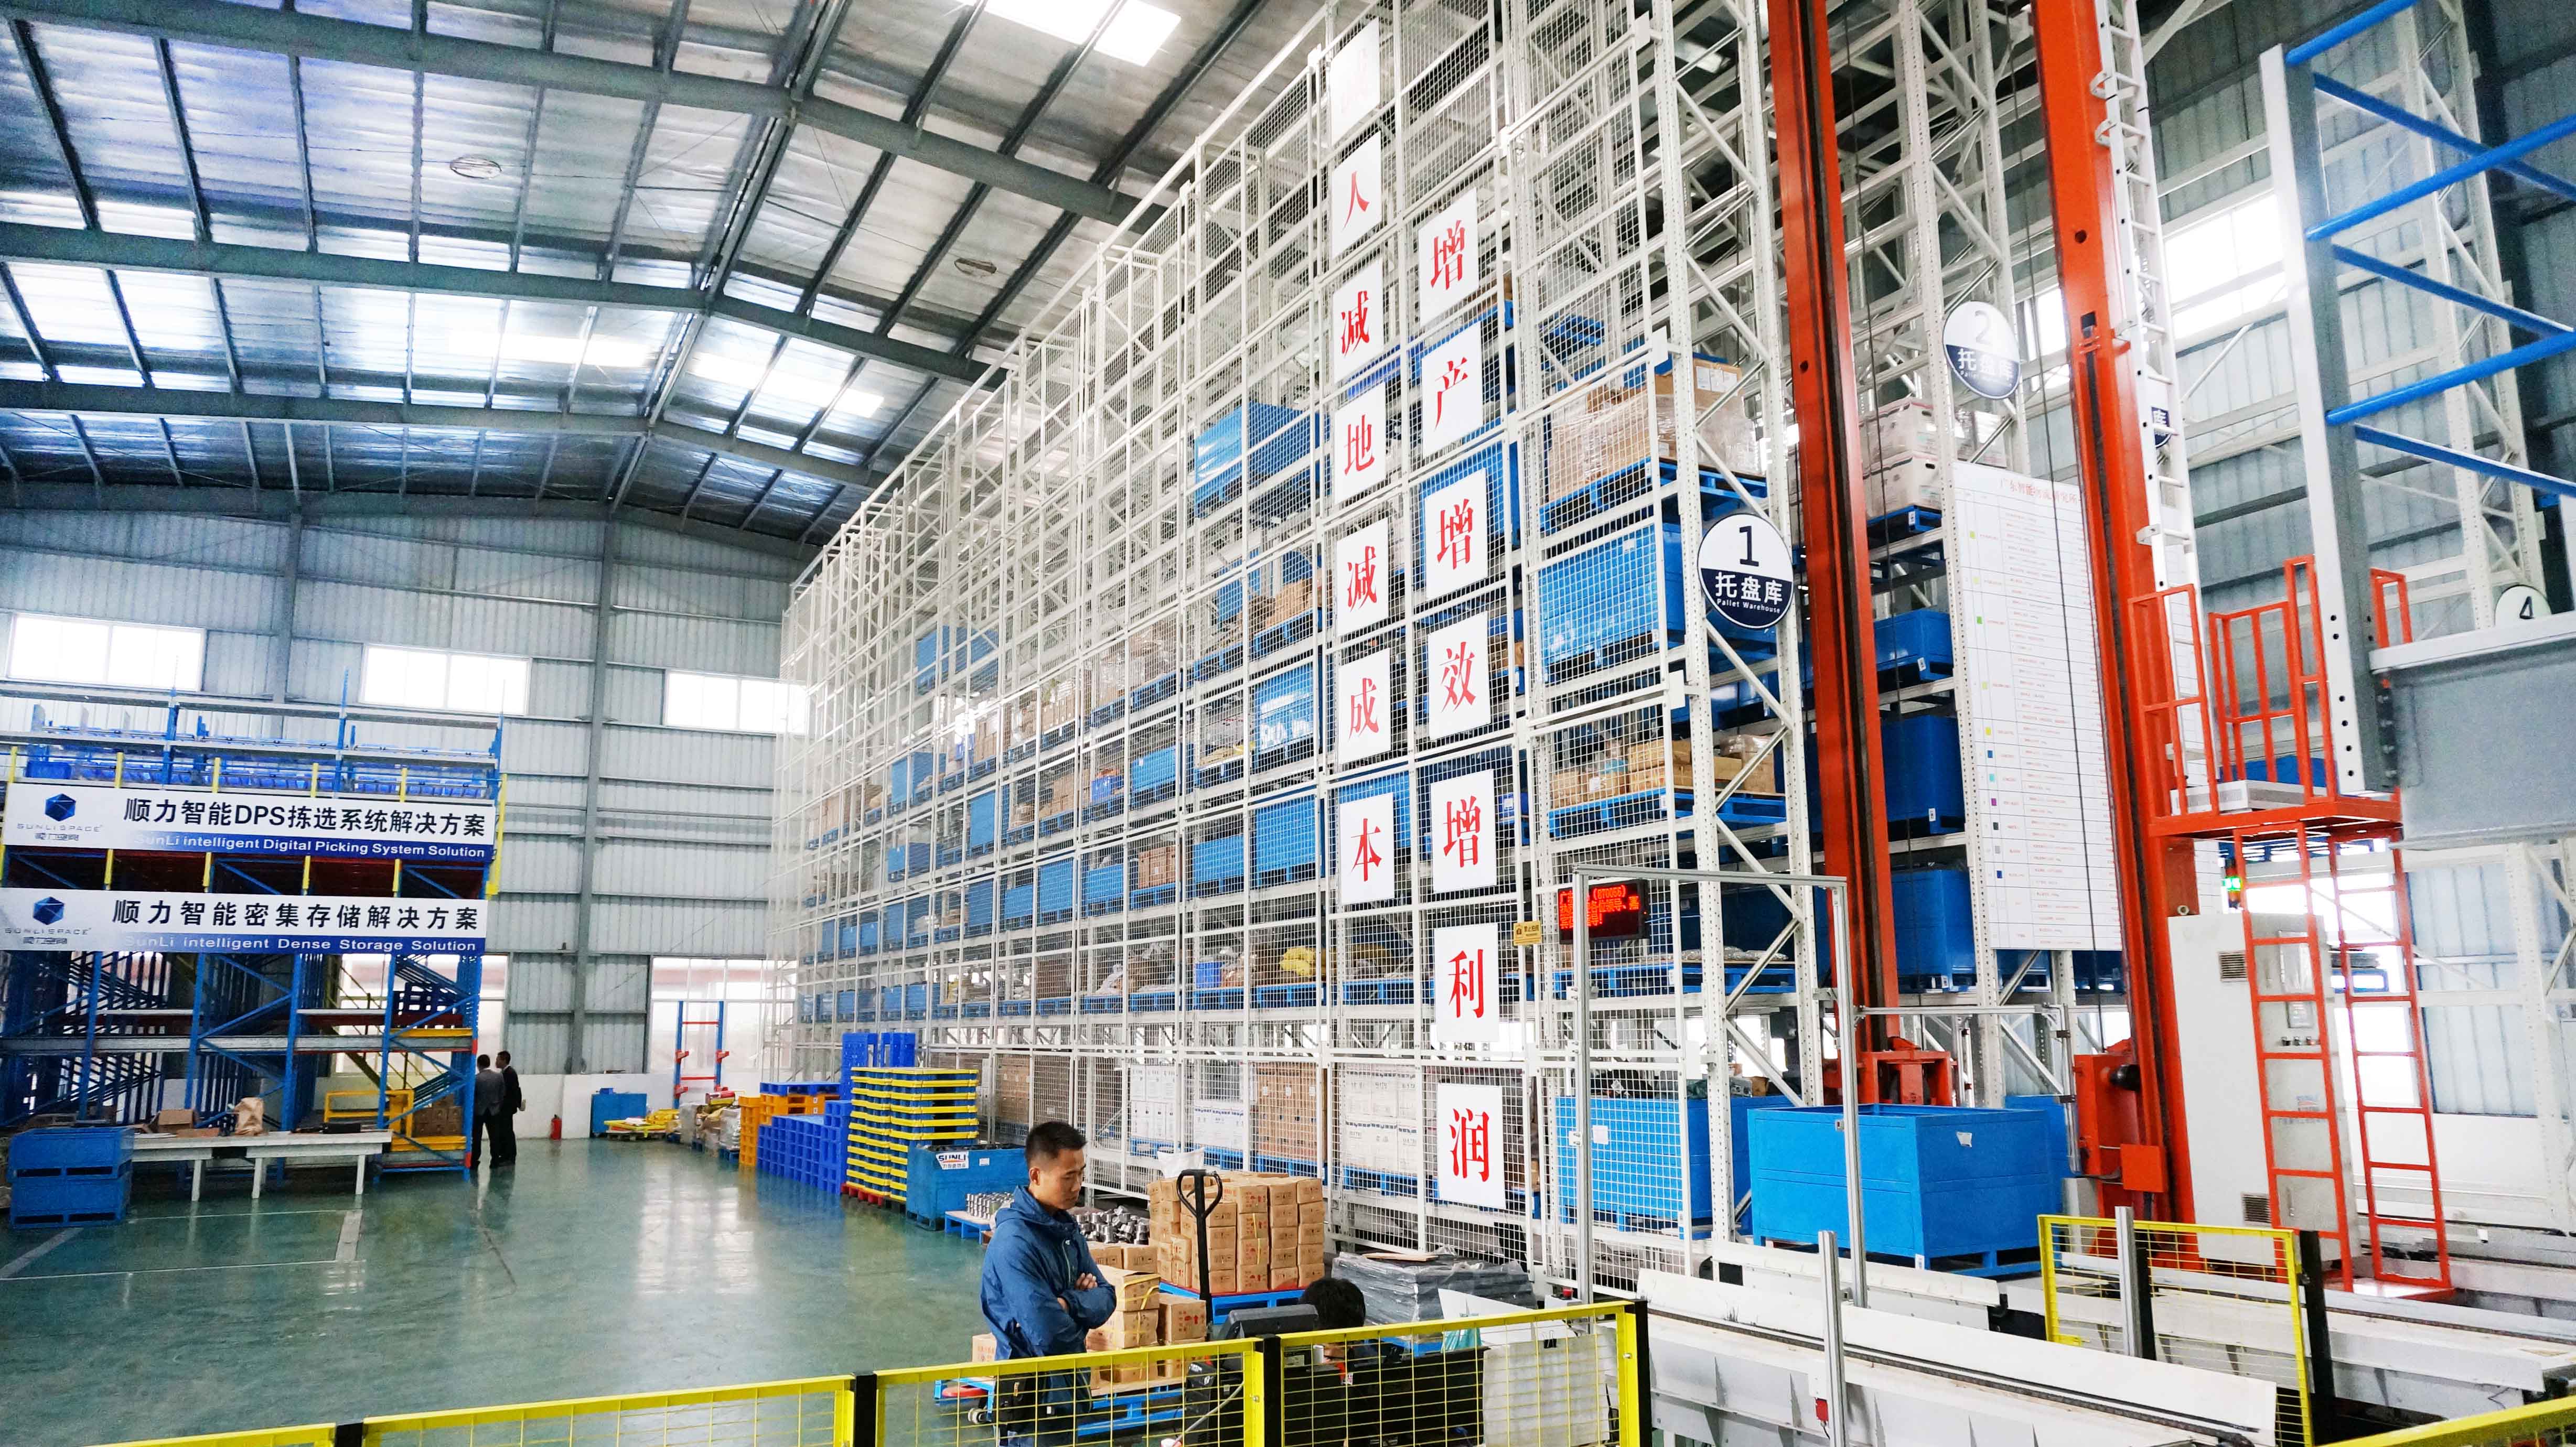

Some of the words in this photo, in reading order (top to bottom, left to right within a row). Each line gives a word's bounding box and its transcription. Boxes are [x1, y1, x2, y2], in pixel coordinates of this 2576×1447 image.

[1739, 525, 1759, 567] 1
[1715, 571, 1783, 605] 托盘库
[1717, 598, 1740, 608] Pallet
[1743, 601, 1780, 614] Warehouse
[124, 797, 486, 836] 顺力智能DPS拣选系统解决方案
[184, 837, 260, 849] intelligent
[263, 839, 312, 851] Digital
[315, 841, 368, 855] Picking
[372, 844, 424, 856] System
[428, 845, 485, 858] Solution
[113, 899, 478, 930] 顺力智能密集存储解决方案
[184, 936, 269, 949] intelligent
[278, 938, 331, 949] Dense
[339, 938, 404, 952] Storage
[411, 940, 476, 952] Solution
